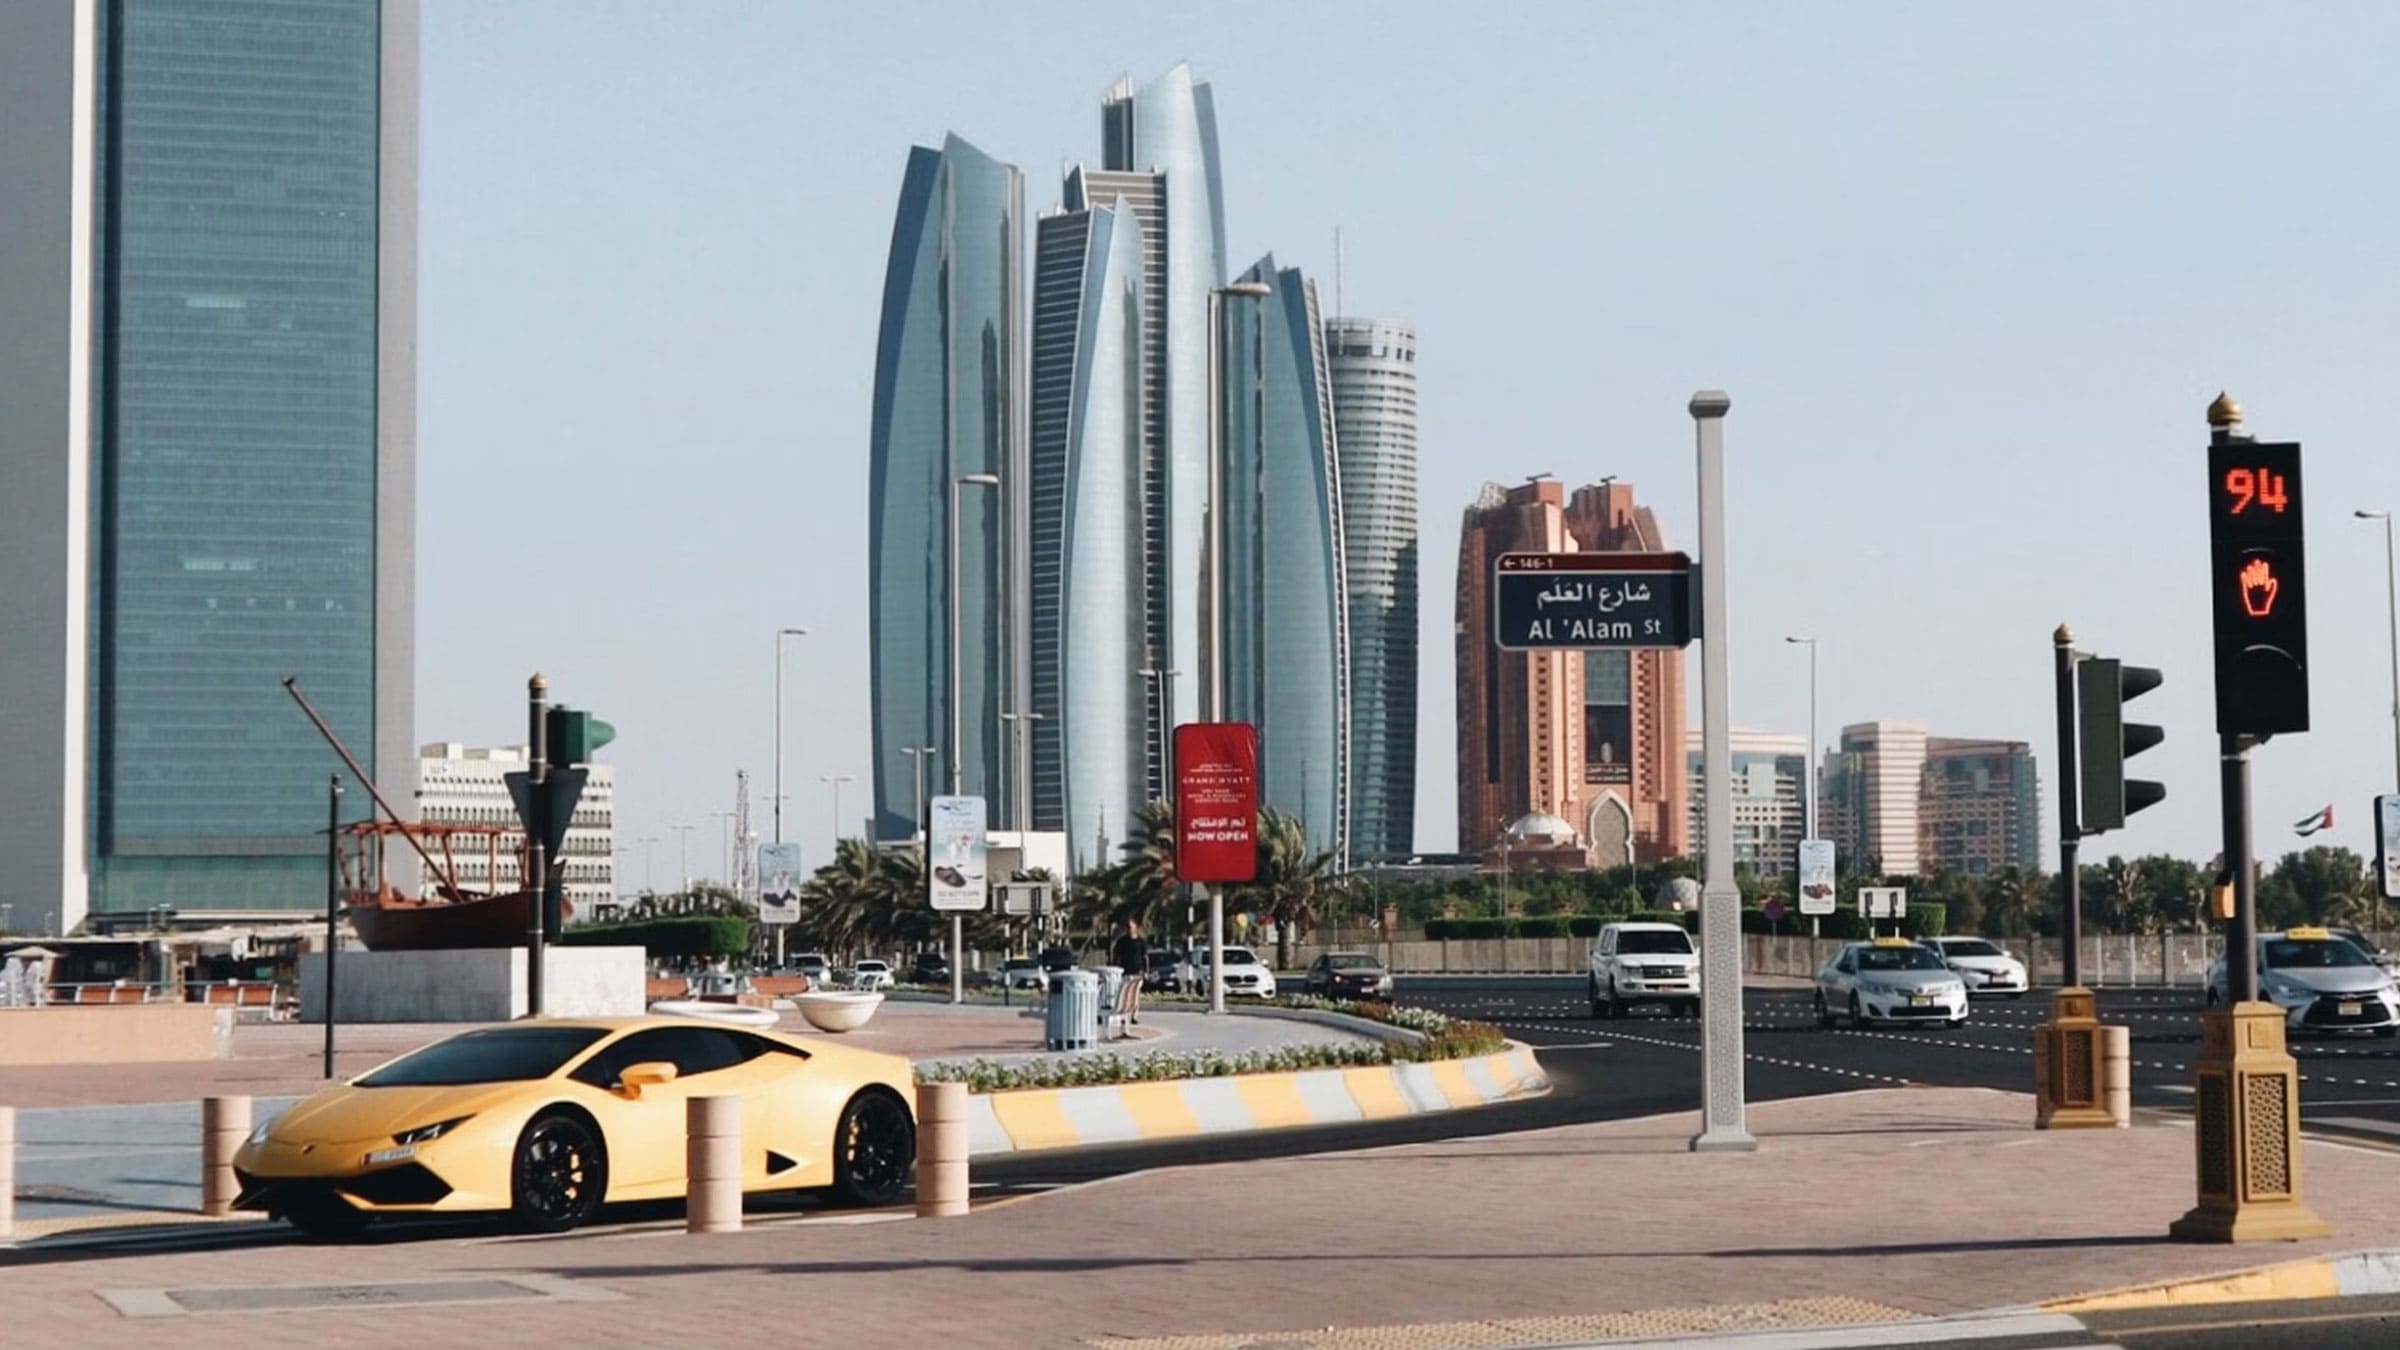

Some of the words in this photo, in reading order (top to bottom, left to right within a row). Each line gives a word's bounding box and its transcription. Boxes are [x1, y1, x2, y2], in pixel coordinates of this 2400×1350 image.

[2226, 468, 2288, 514] 94
[1520, 557, 1553, 569] 146-1
[1598, 581, 1650, 612] شارع
[1529, 619, 1552, 639] Al
[1563, 619, 1632, 639] 'Alam
[1644, 618, 1661, 635] St
[1187, 831, 1215, 841] NOW
[1217, 831, 1248, 841] OPEN
